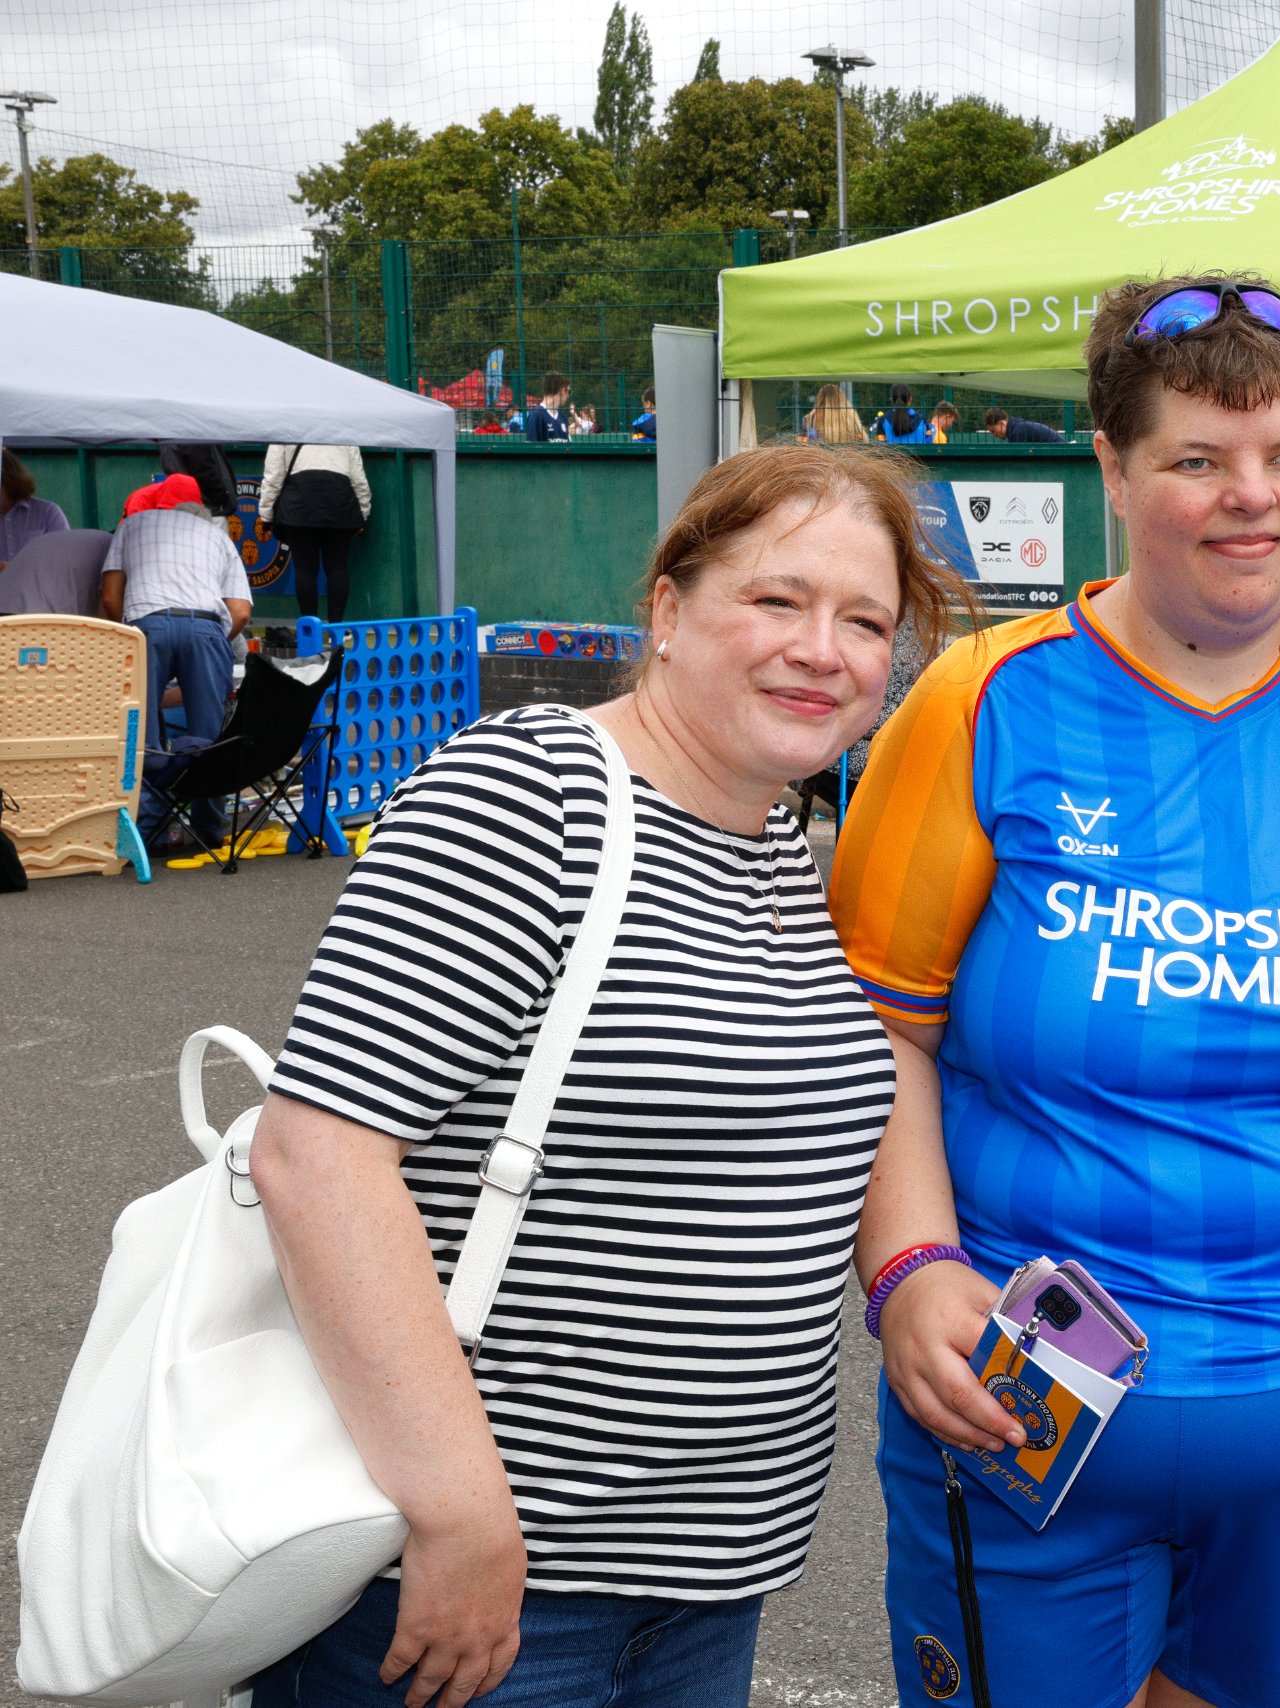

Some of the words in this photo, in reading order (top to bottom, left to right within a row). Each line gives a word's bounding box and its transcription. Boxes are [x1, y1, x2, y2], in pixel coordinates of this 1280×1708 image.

[1116, 195, 1261, 222] HOMES
[865, 295, 1099, 337] SHROPSH
[236, 483, 254, 495] OWN
[986, 1375, 1016, 1392] HREWSBURY
[1017, 1382, 1037, 1400] TOWN
[1036, 1399, 1054, 1434] FOOTBALL
